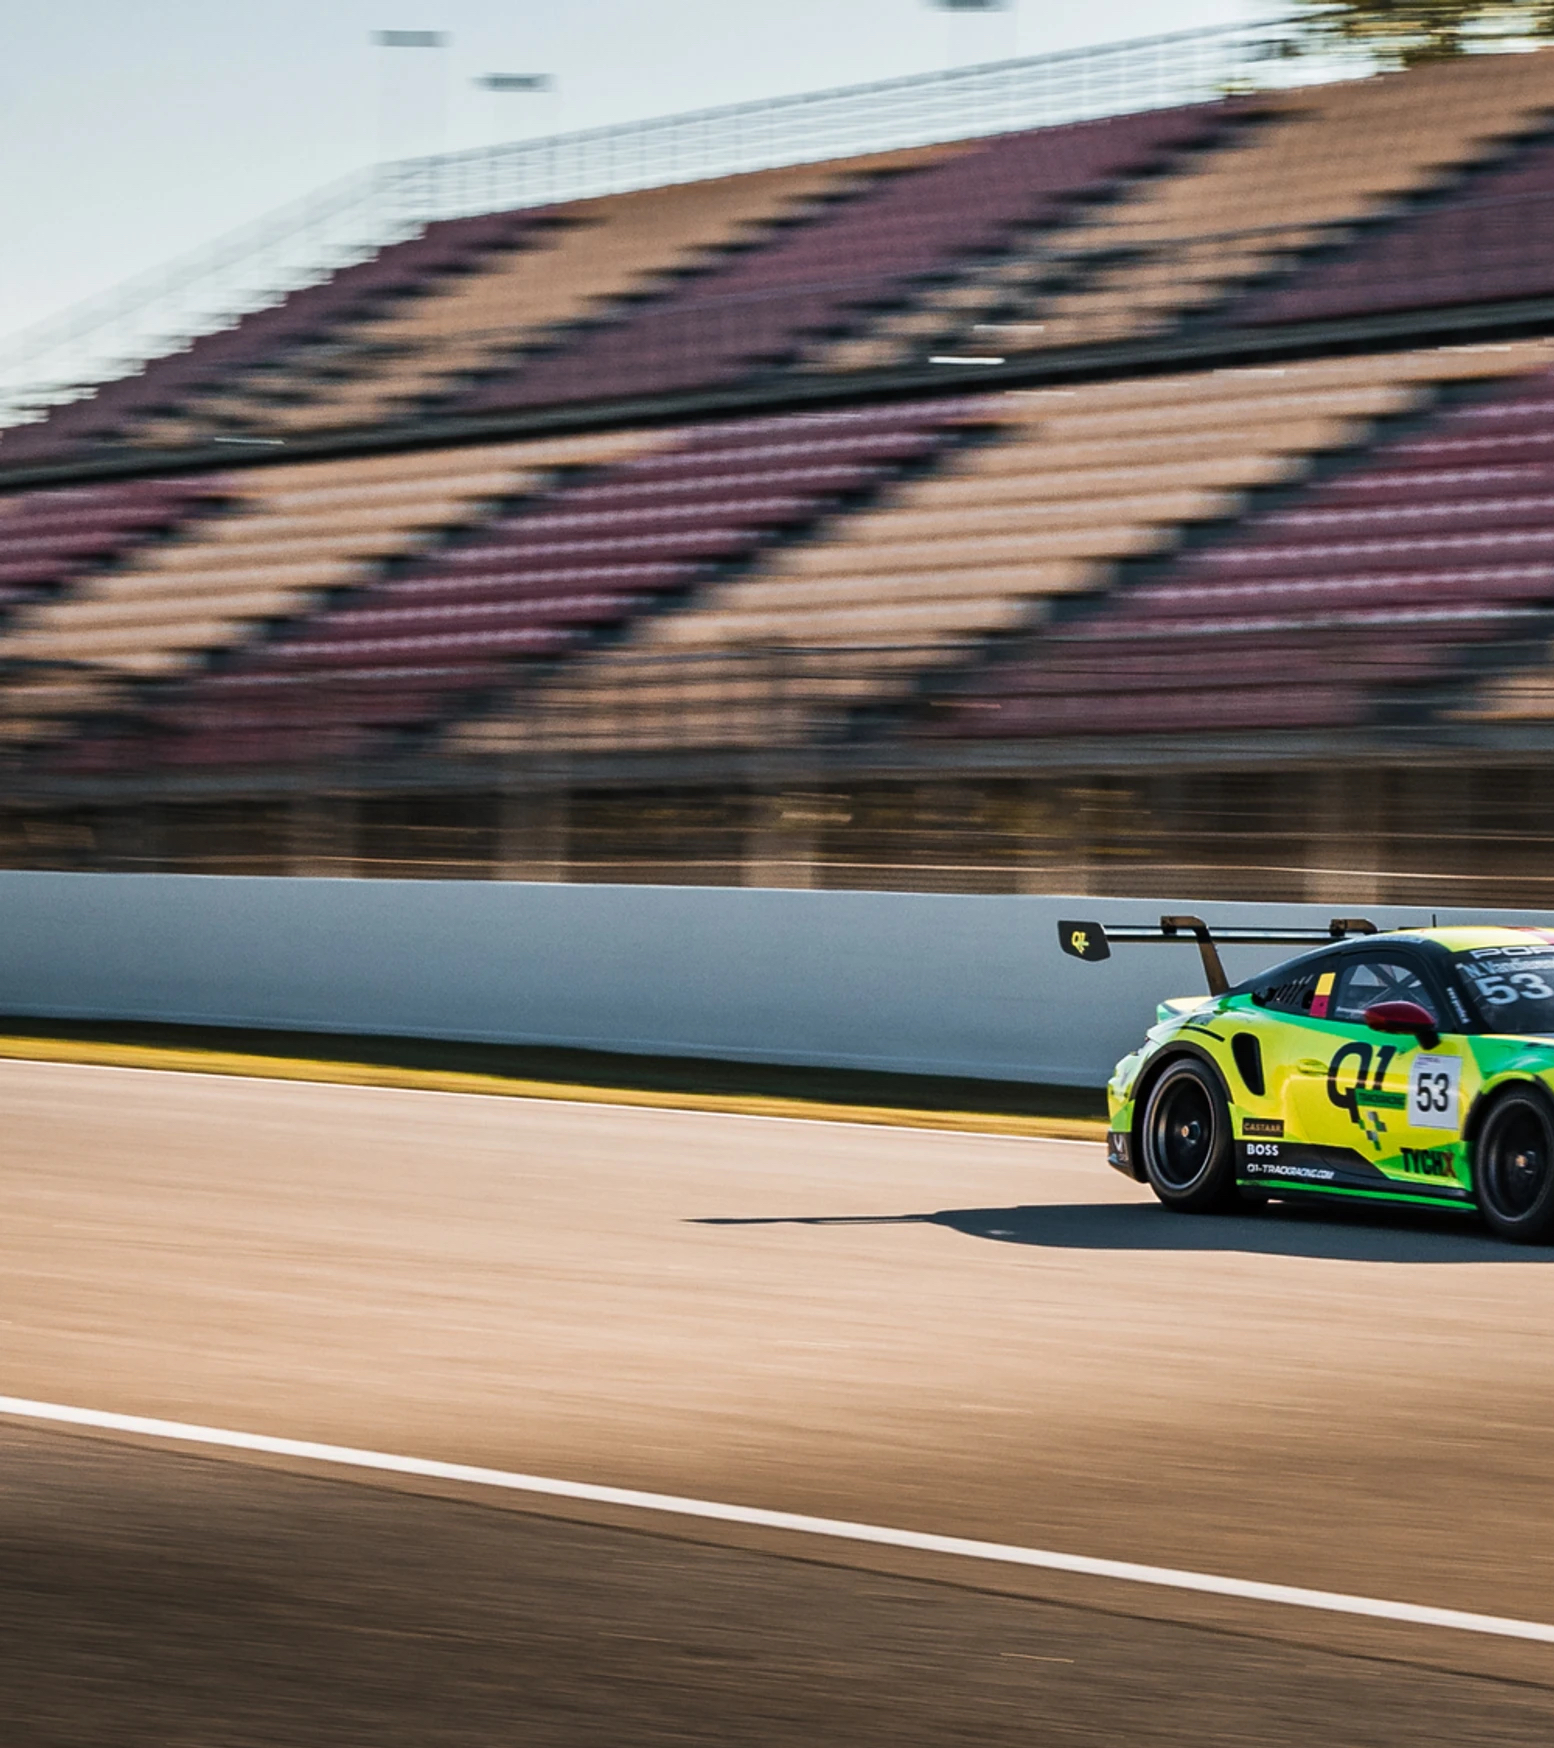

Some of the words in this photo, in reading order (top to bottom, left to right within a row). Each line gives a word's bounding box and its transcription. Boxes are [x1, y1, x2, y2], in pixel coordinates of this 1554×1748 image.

[1326, 1041, 1398, 1124] Q1
[1416, 1072, 1450, 1113] 53
[1246, 1143, 1280, 1157] BOSS
